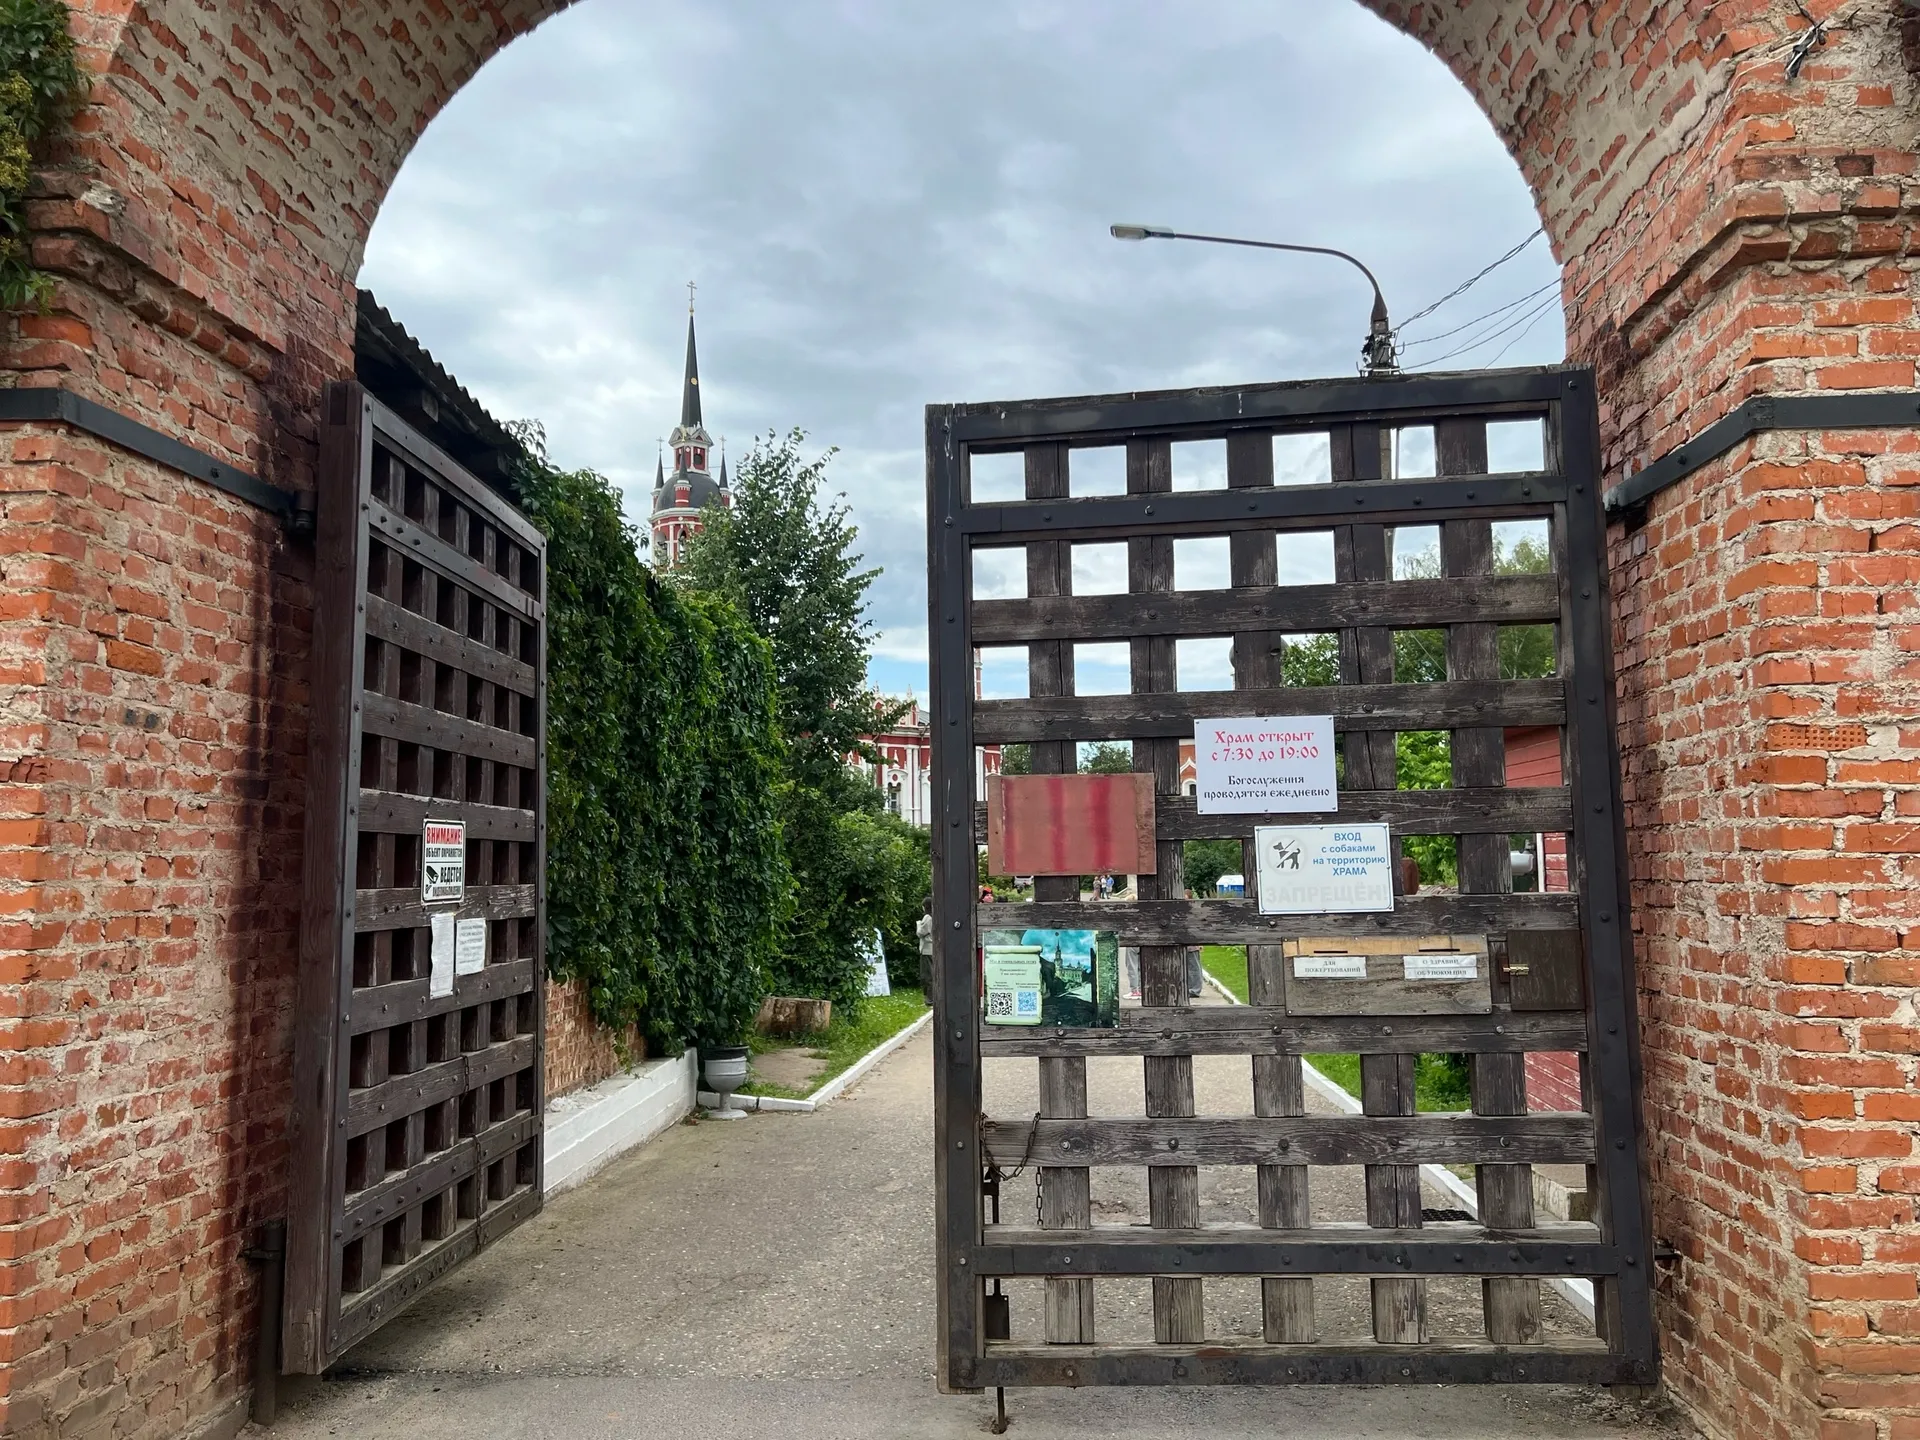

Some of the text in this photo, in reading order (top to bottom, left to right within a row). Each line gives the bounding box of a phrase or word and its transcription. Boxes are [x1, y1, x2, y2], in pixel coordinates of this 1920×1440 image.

[1215, 731, 1314, 746] Храм открыт
[1211, 746, 1319, 762] с 7:30 до 19:00
[1228, 775, 1304, 787] Богослужения
[1204, 788, 1330, 801] проводятся ежедневно
[427, 827, 462, 844] ВНИМАНИЕ!
[1334, 832, 1362, 842] ВХОД
[1329, 844, 1376, 853] собаками
[1327, 856, 1386, 866] территорию
[1332, 867, 1367, 876] ХРАМА
